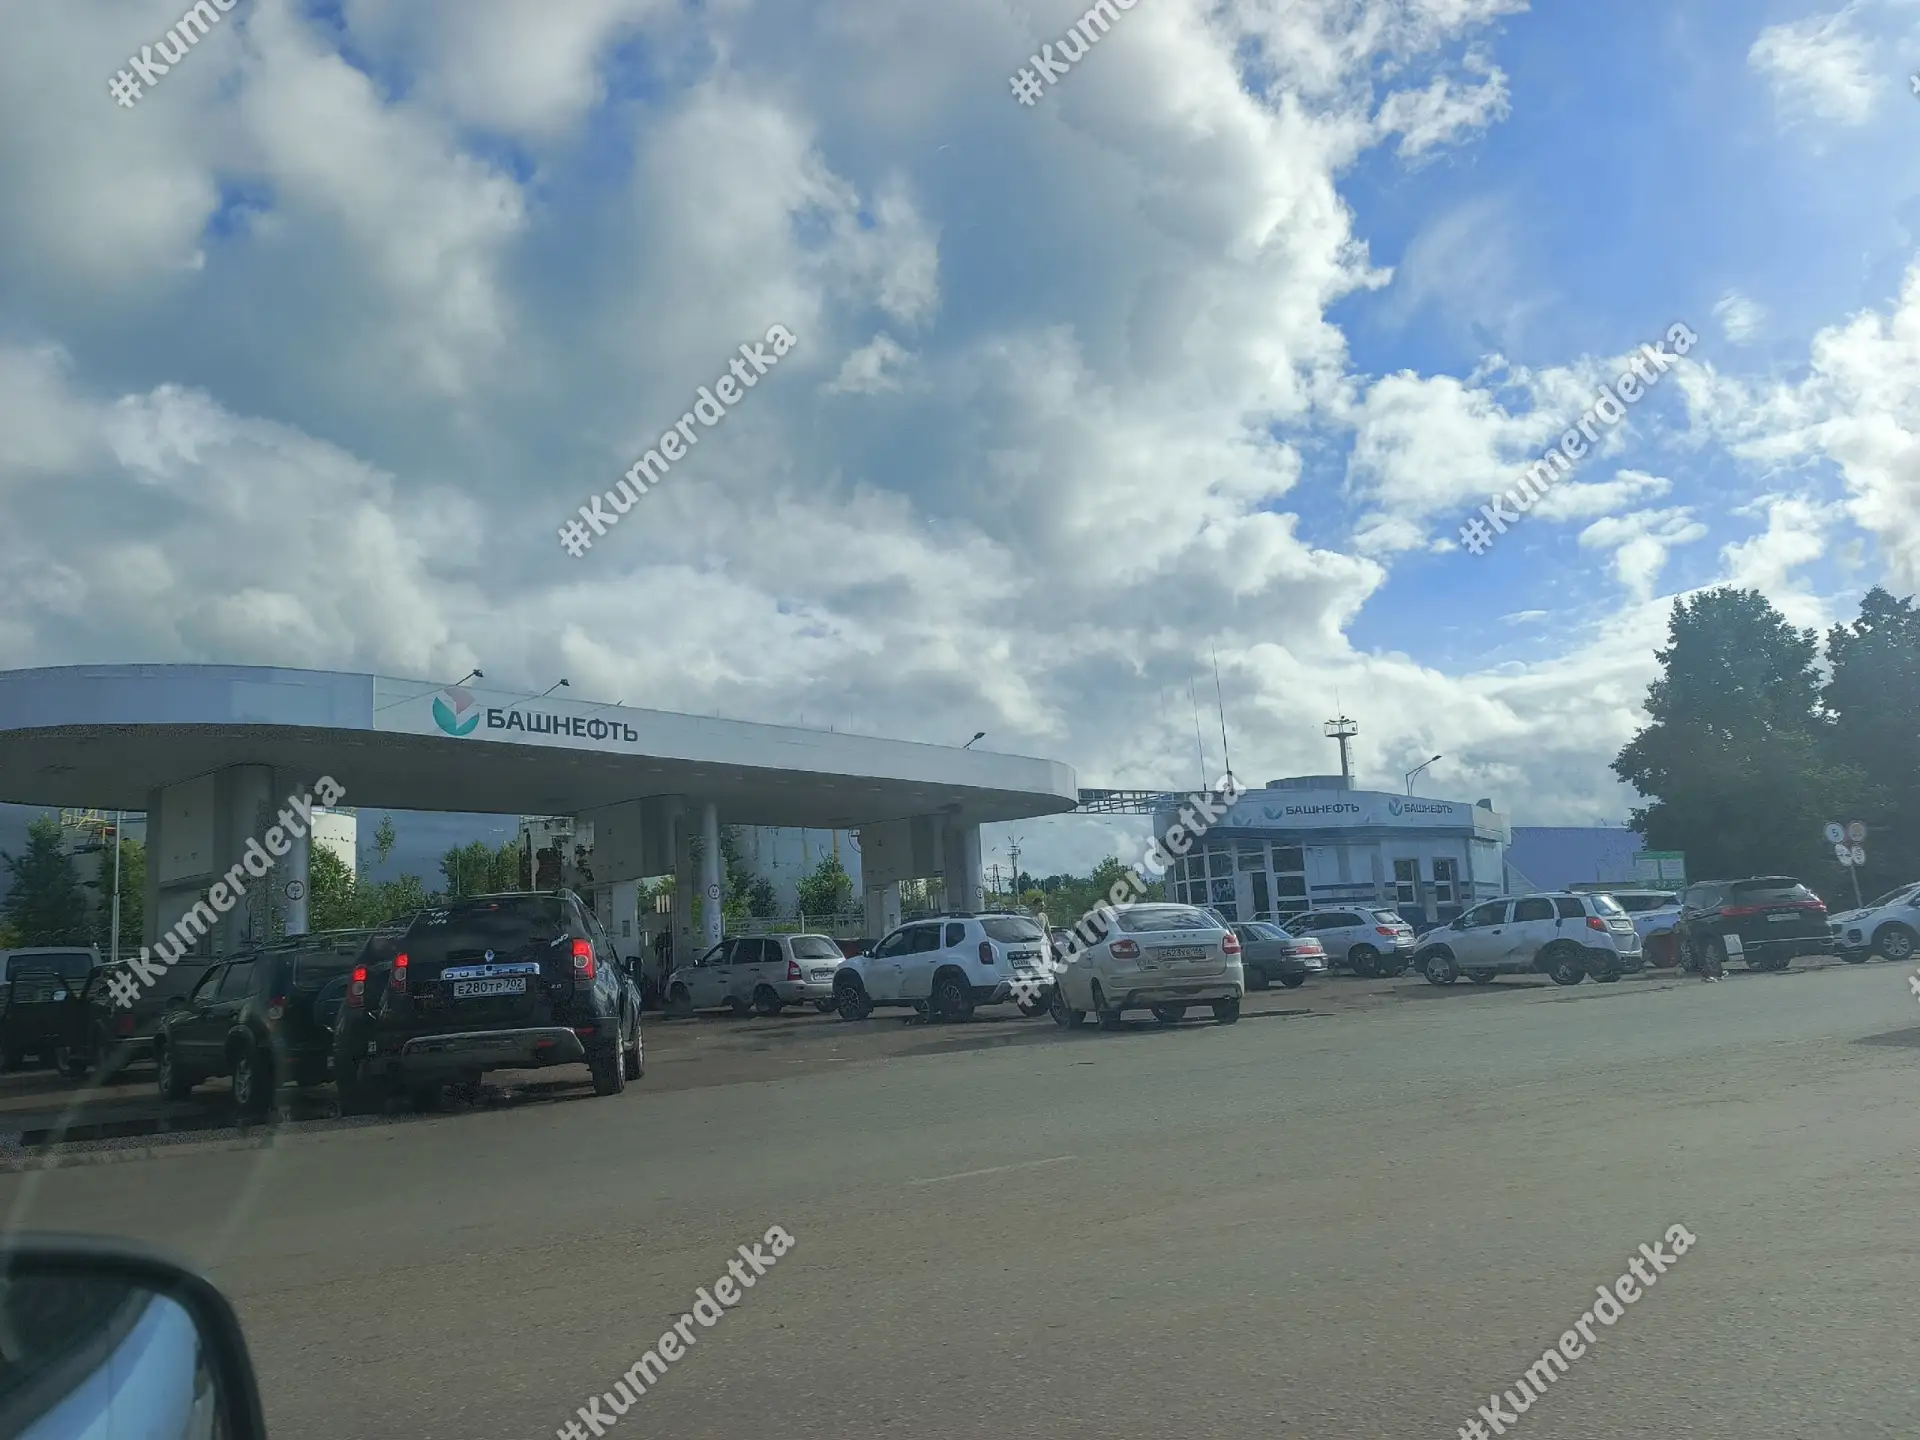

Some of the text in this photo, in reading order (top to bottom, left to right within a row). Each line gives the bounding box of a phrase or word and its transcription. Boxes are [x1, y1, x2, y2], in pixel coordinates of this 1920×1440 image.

[487, 708, 638, 742] БАШНЕФТЬ
[1286, 803, 1360, 816] БАШНЕФТЬ
[1404, 802, 1453, 815] БАШНЕФТЬ
